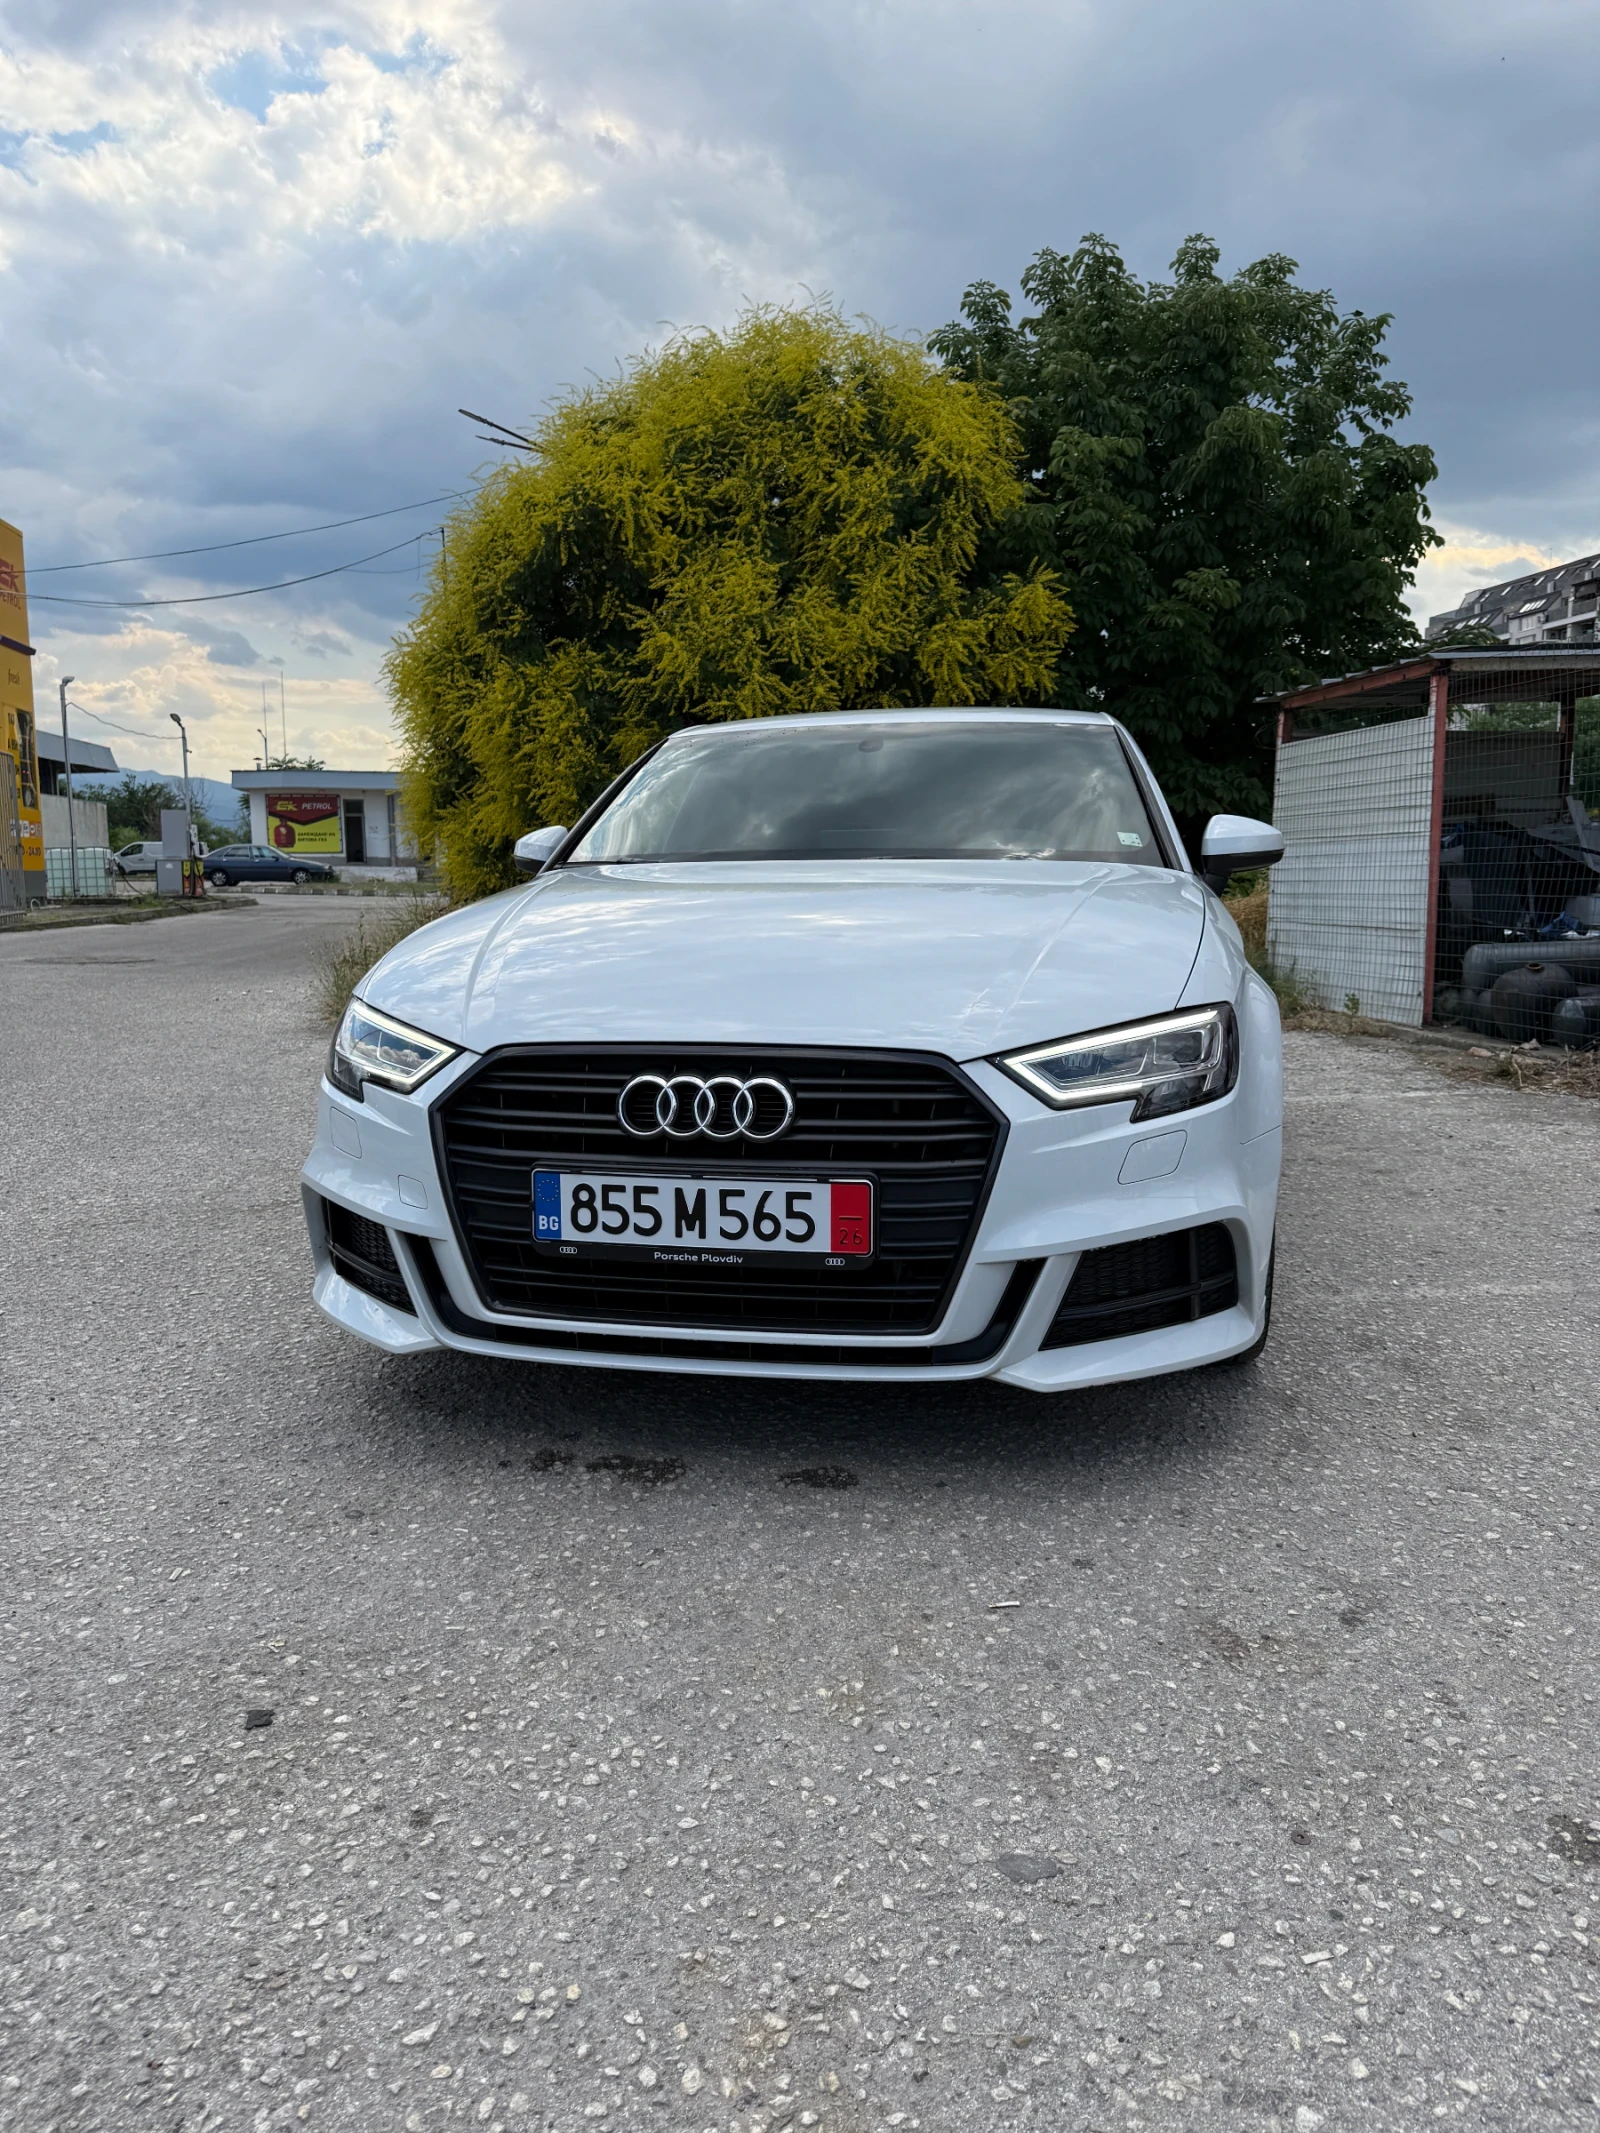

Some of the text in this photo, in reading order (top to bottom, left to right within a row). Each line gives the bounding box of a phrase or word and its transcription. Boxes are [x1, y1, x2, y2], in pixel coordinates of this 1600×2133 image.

[571, 1183, 815, 1243] 855 M 565
[538, 1215, 559, 1230] BG
[839, 1228, 863, 1245] 26
[654, 1252, 743, 1263] Porsche Plovdiv
